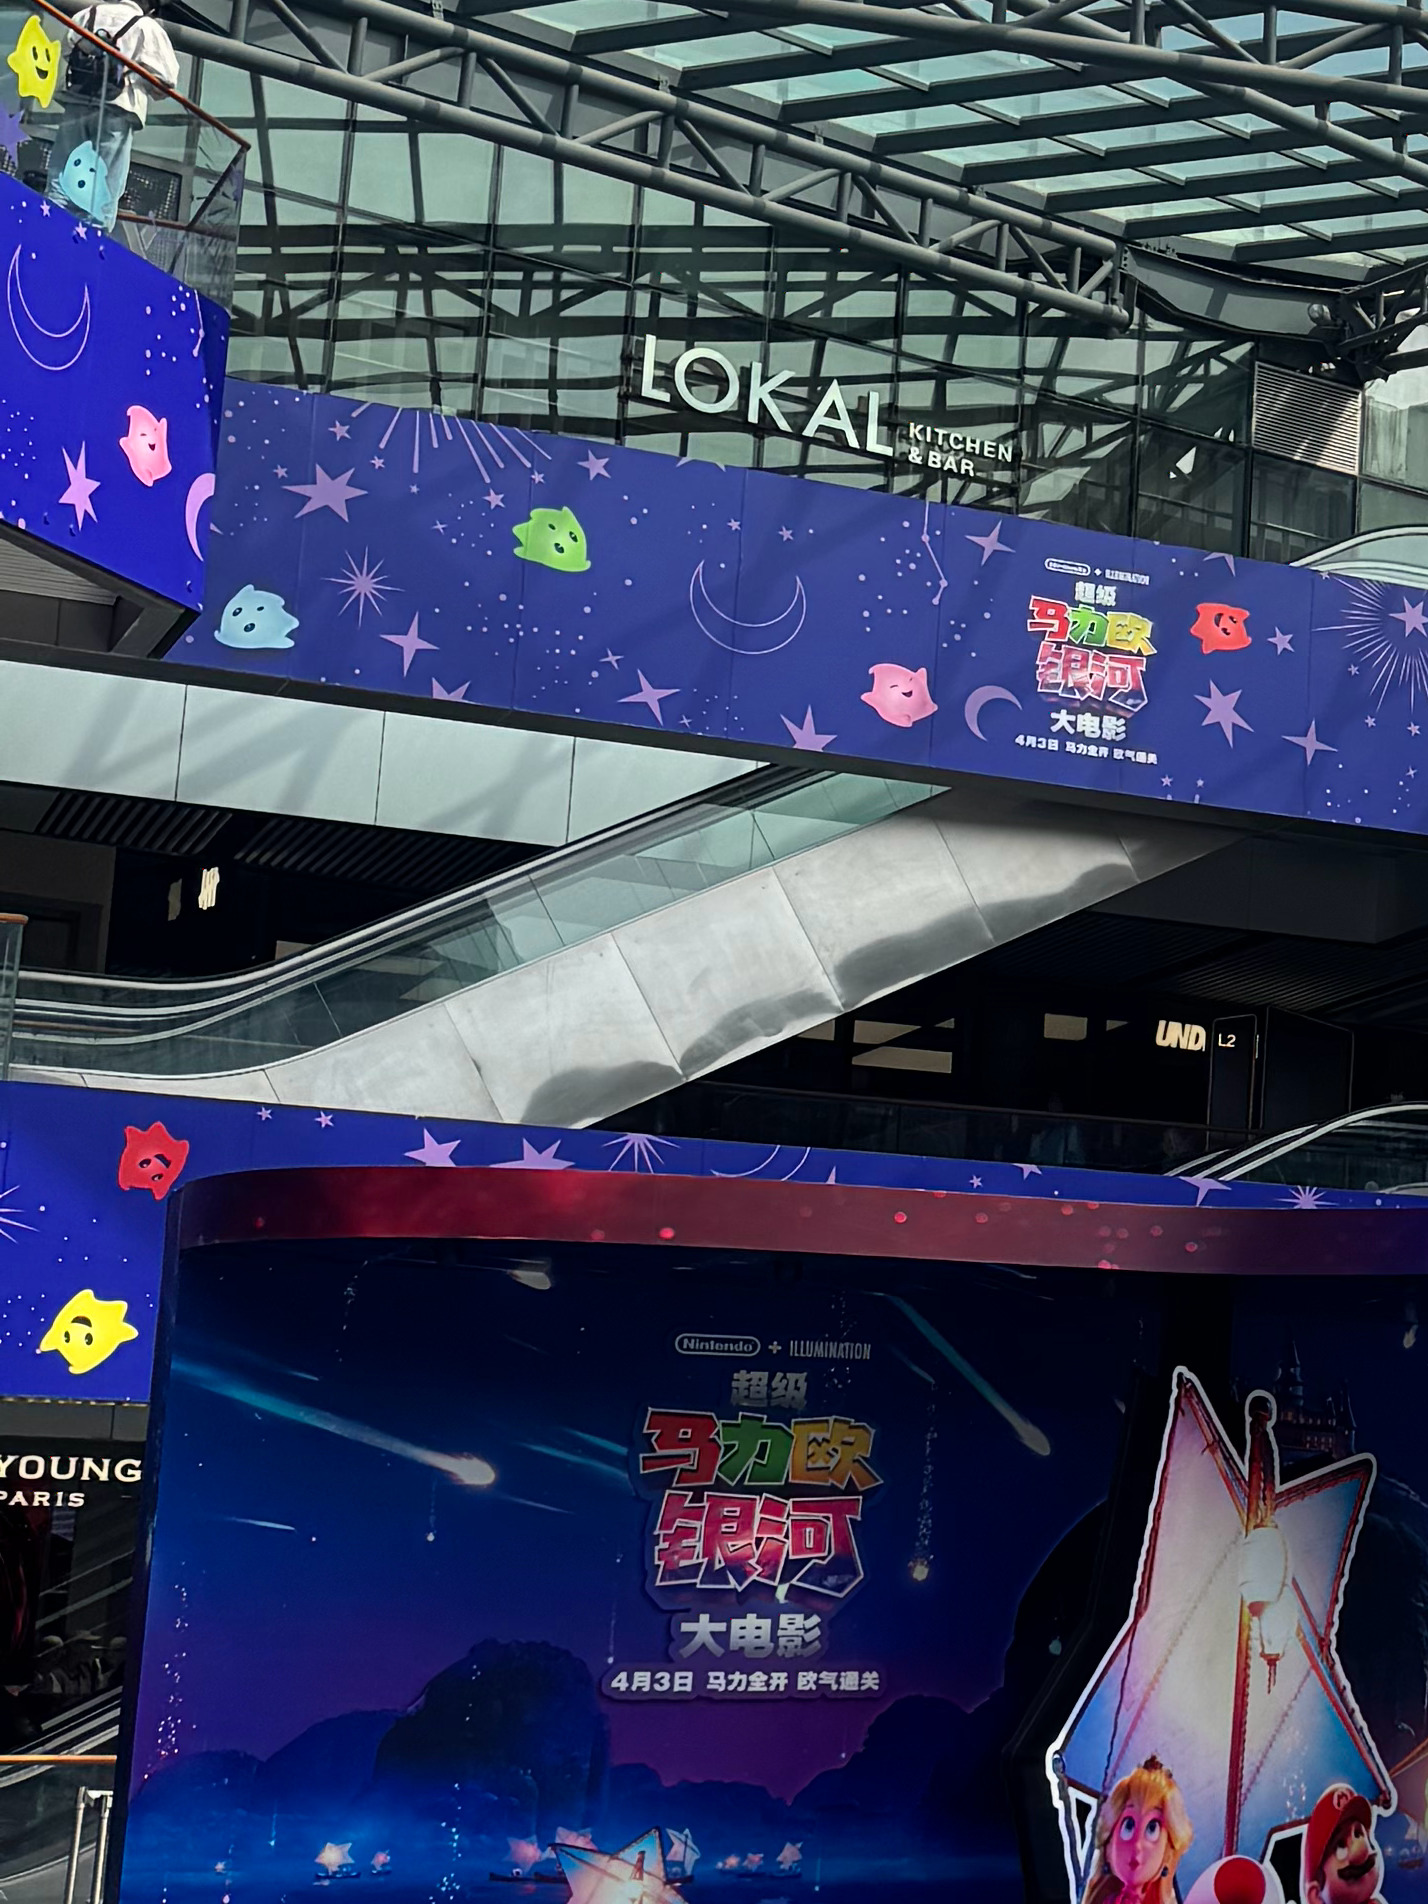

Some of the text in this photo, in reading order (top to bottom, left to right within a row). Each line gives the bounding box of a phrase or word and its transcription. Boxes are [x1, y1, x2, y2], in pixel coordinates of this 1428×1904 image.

[641, 334, 893, 456] LOKAL
[908, 422, 1013, 463] KITCHEN
[1027, 595, 1158, 655] 马力欧
[1036, 641, 1149, 712] 银河
[1050, 709, 1126, 741] 大电影
[1218, 1033, 1236, 1047] L2
[683, 1337, 754, 1353] Nintendo
[789, 1340, 871, 1360] ILLUMINATION
[731, 1370, 808, 1409] 超级
[0, 1455, 142, 1483] YOUNG
[639, 1407, 884, 1492] 马力欧
[653, 1490, 865, 1598] 银河
[679, 1613, 822, 1658] 大电影
[611, 1671, 880, 1692] 4月3日 马力全开 欧气通关
